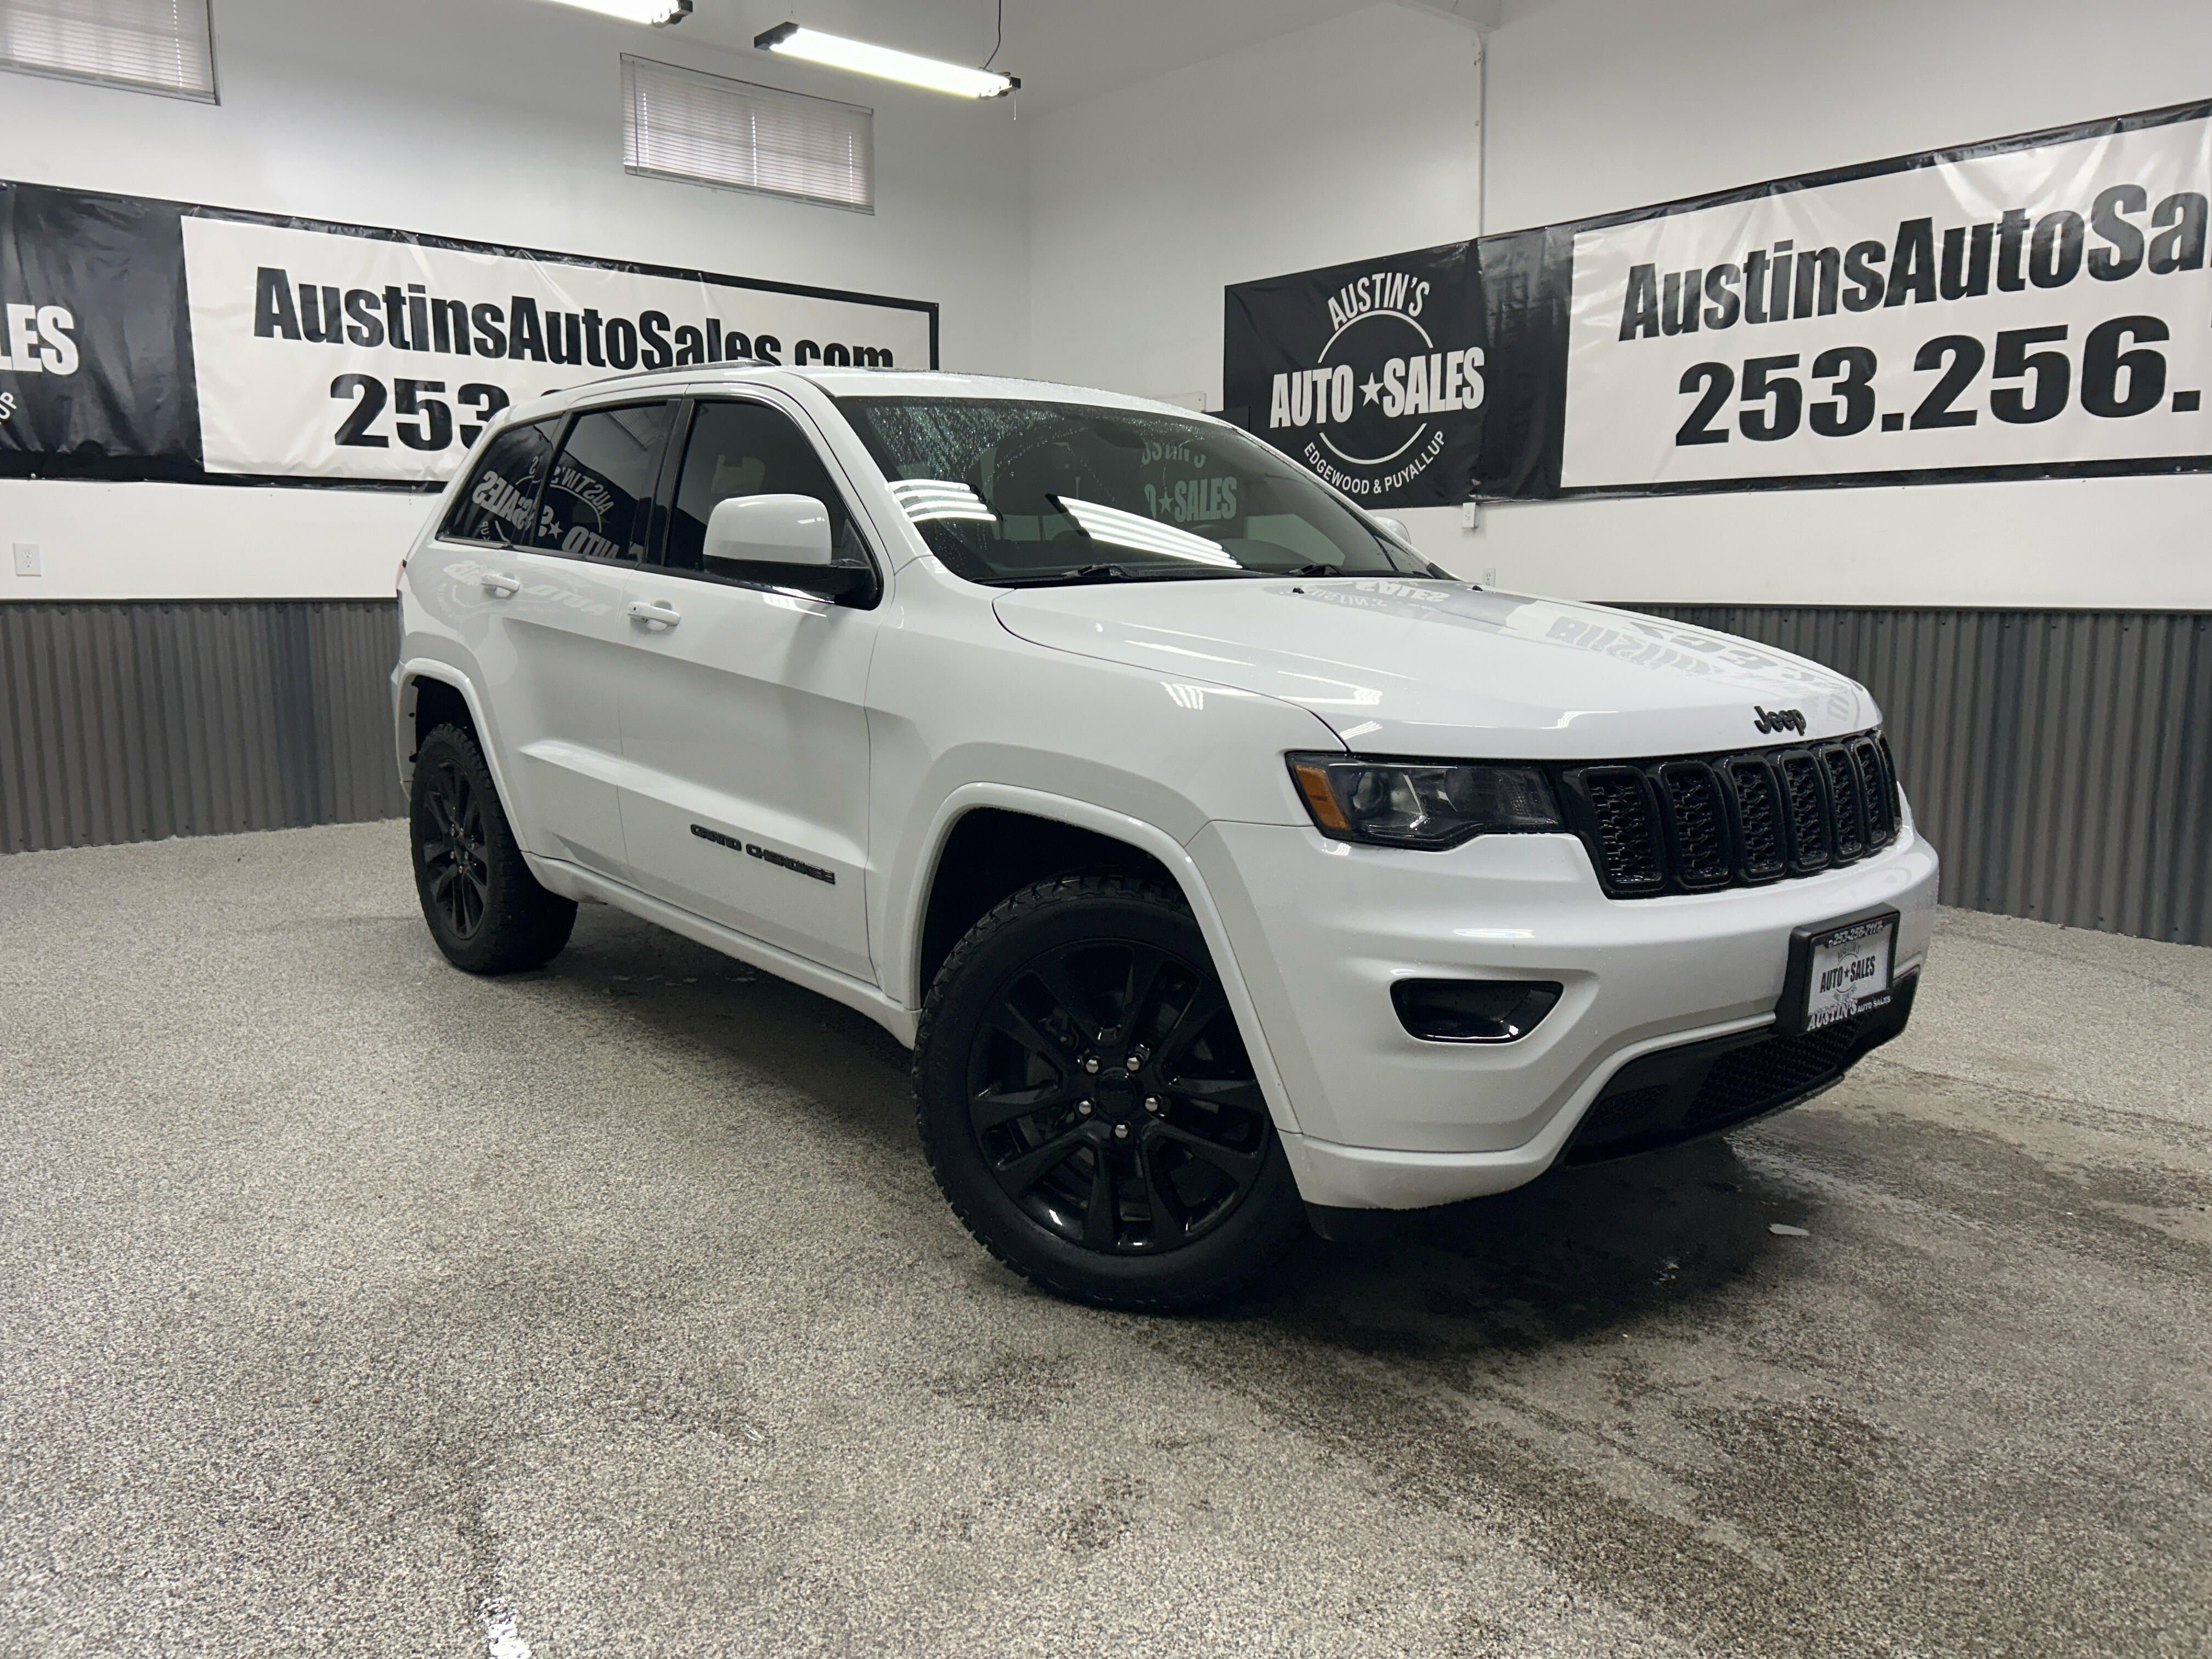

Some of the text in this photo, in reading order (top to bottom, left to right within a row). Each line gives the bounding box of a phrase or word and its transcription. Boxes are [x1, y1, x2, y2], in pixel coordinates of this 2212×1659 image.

[1619, 184, 2212, 341] AustinsAutoSa
[254, 266, 893, 370] AustinsAutoSalescom
[1327, 272, 1430, 331] AUSTIN'S
[1269, 347, 1485, 428] AUTO SALES
[1675, 314, 2212, 447] 253.256.
[330, 373, 563, 452] 253
[1304, 431, 1447, 494] EDGEWOOD & PUYALLUP
[1175, 476, 1238, 523] SALES
[1754, 706, 1807, 736] Jeep
[1820, 966, 1843, 994] AUTO
[1850, 955, 1876, 983] SALES
[1807, 995, 1891, 1031] AUSTIN'S AUTO SALES
